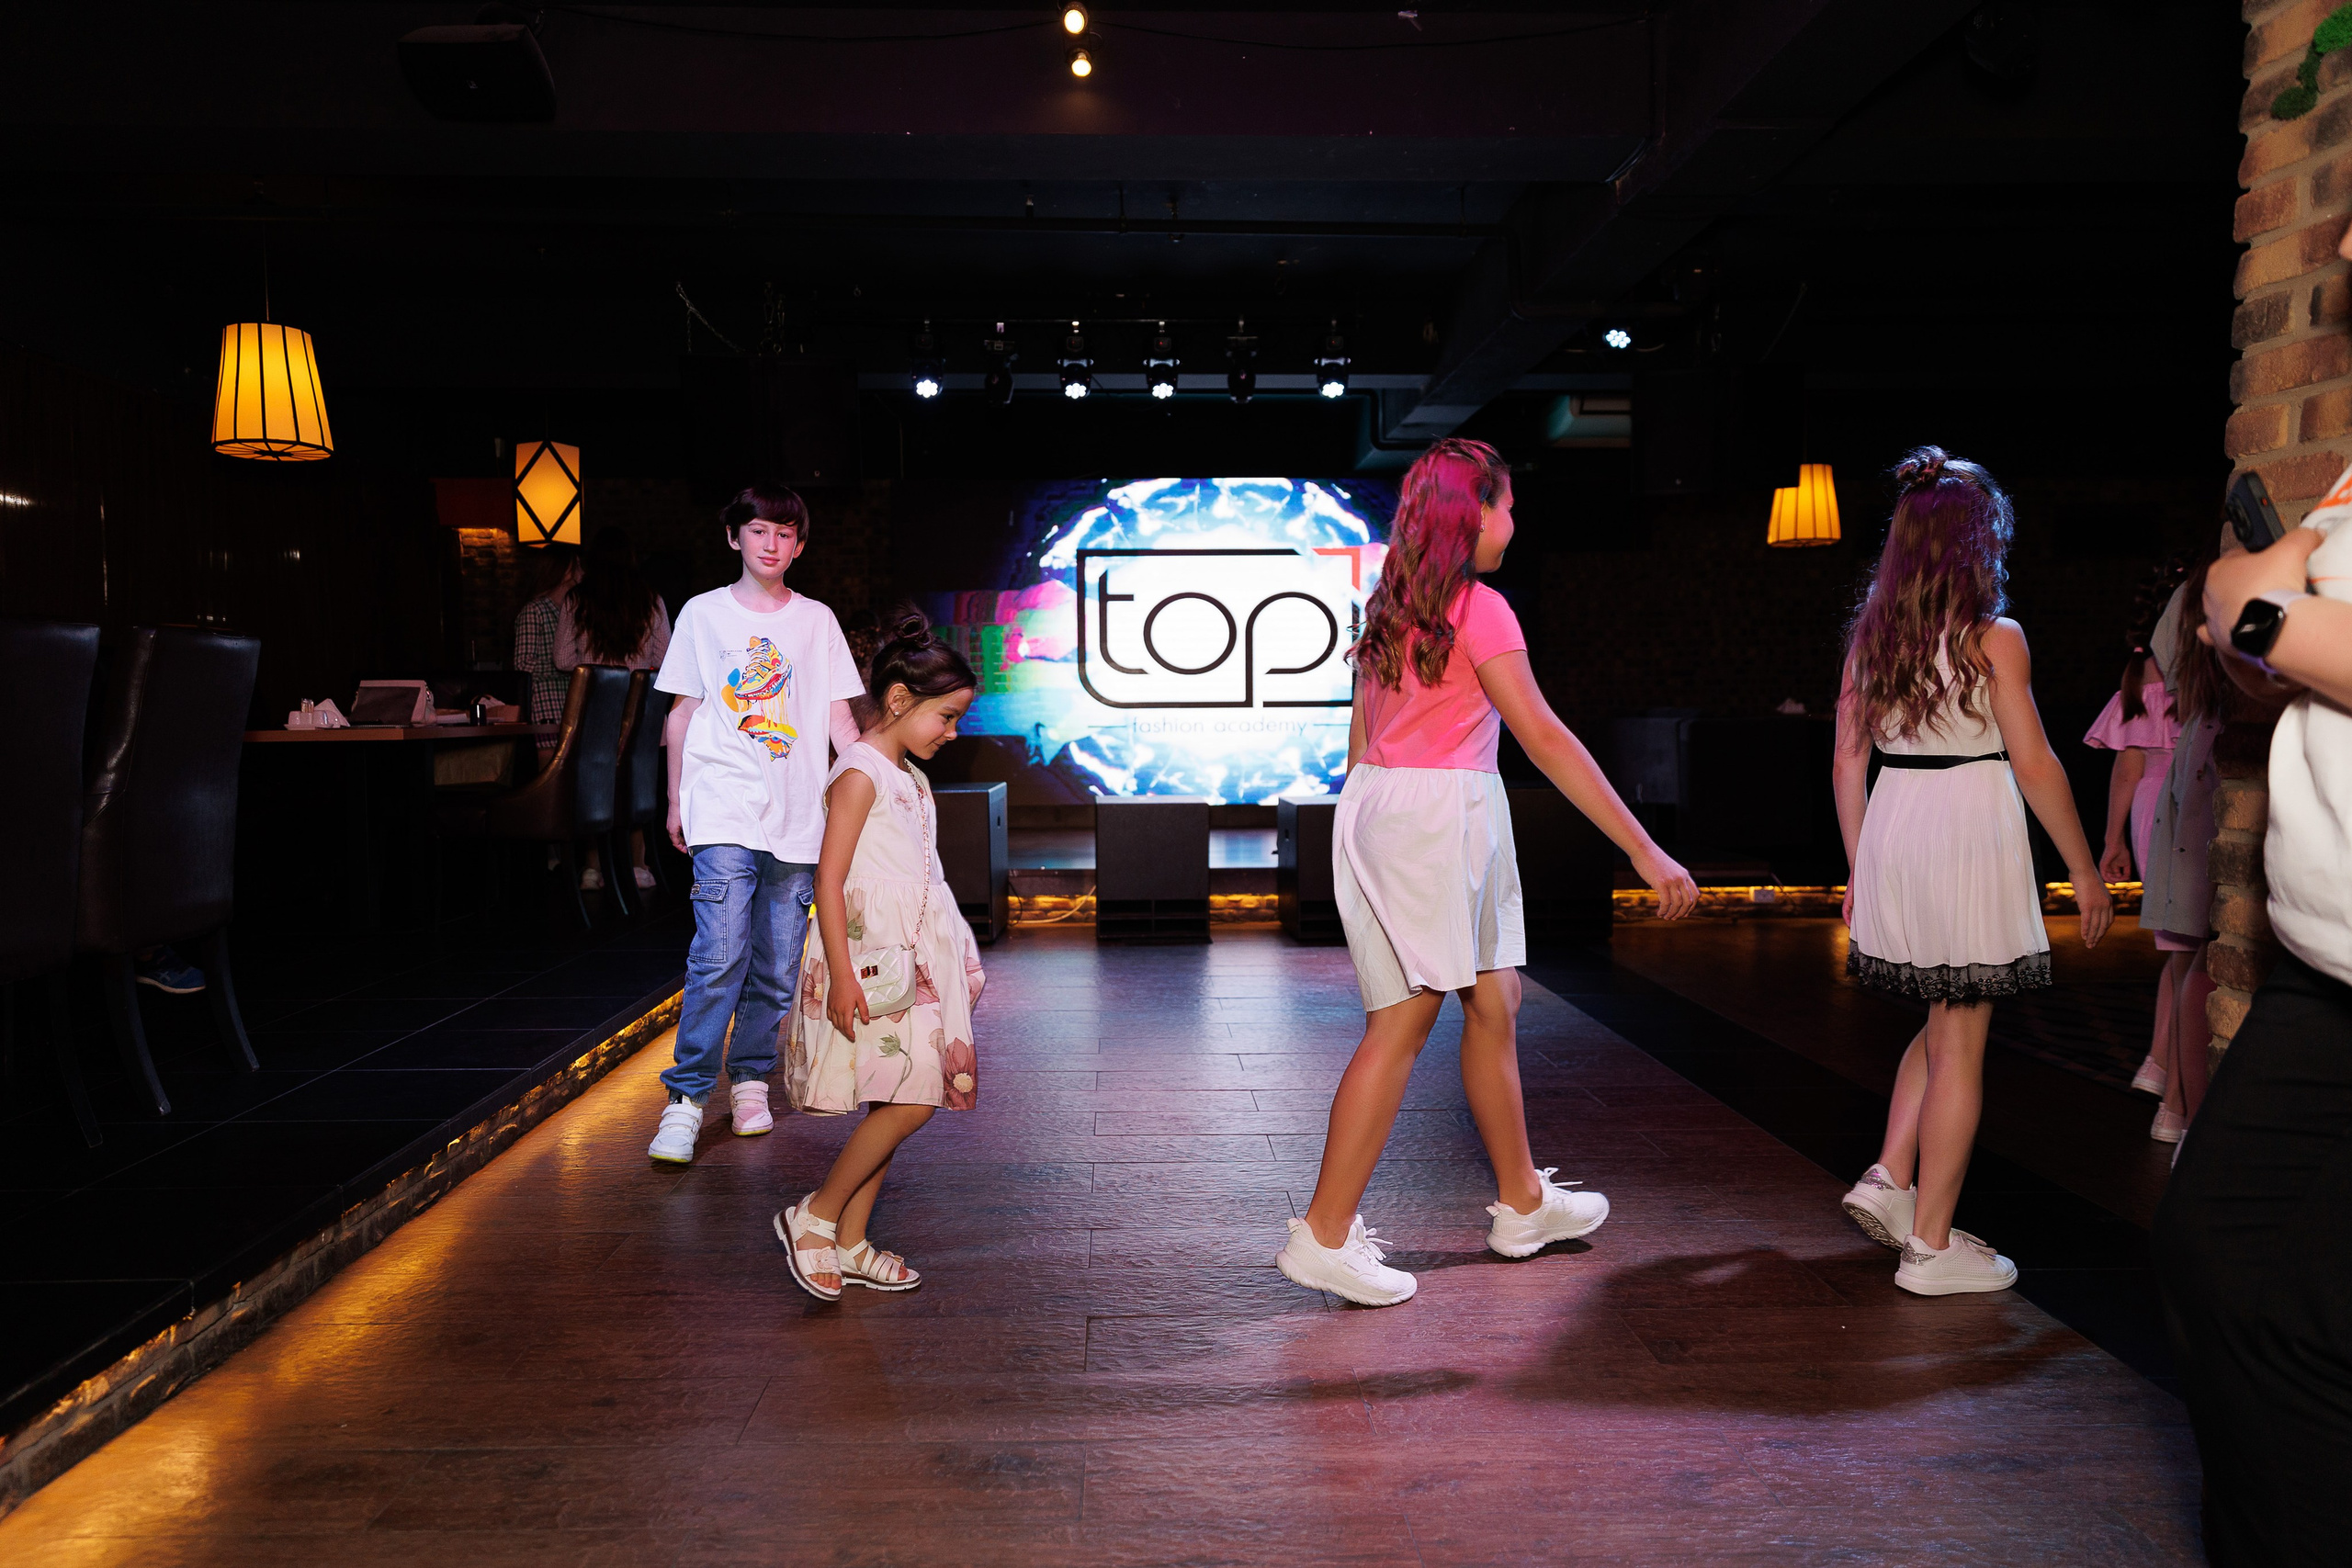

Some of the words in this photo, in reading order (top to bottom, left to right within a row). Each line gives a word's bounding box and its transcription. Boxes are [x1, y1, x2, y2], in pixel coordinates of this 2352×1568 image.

[1099, 570, 1338, 707] top
[1133, 716, 1204, 734] fashion
[1214, 715, 1307, 736] academy
